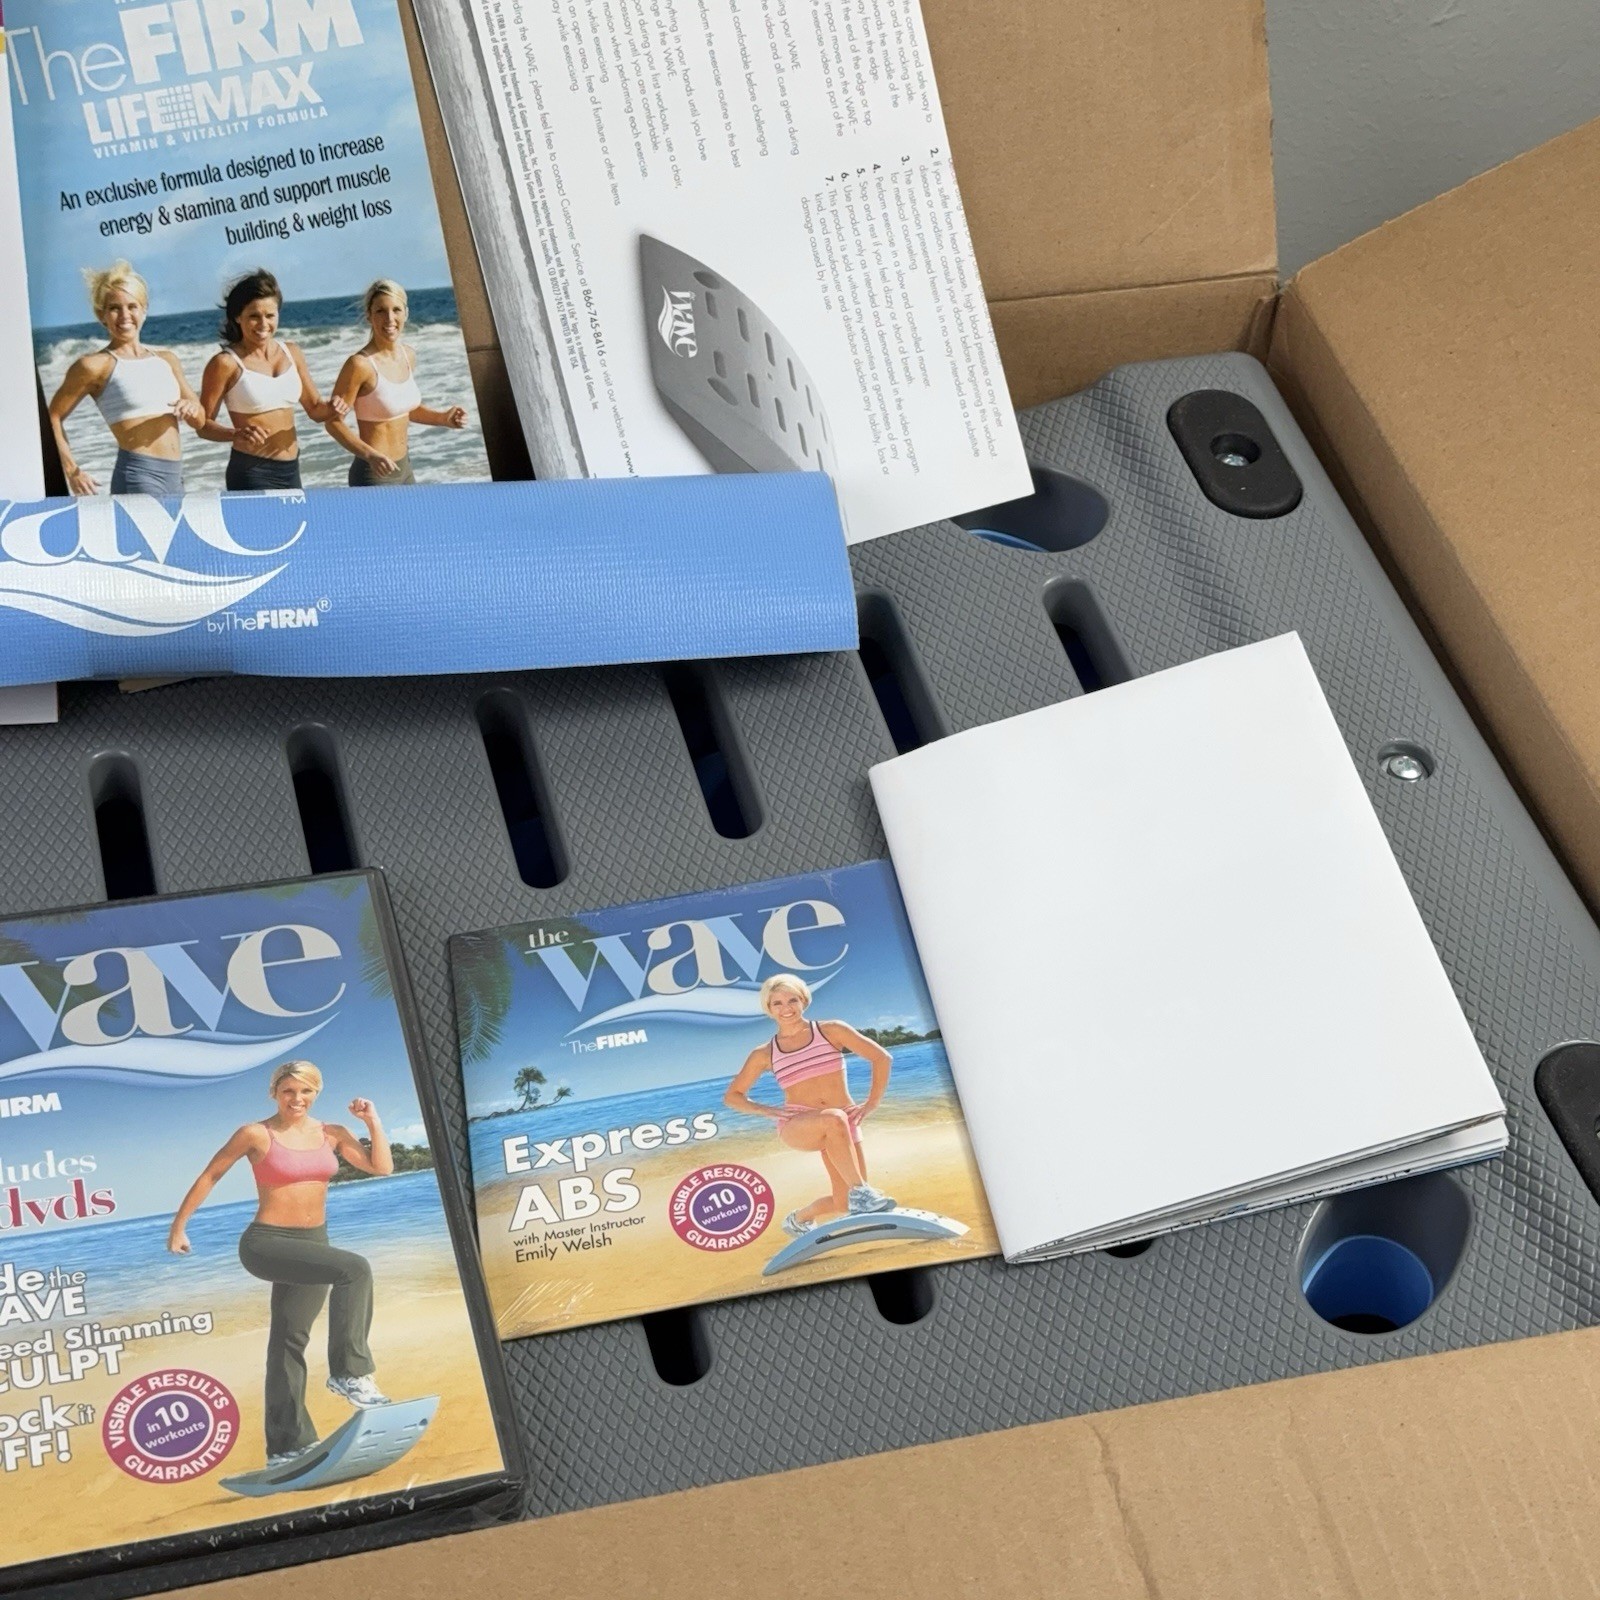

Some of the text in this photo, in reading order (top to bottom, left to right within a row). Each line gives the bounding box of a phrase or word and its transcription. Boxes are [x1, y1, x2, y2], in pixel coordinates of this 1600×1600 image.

[602, 1, 616, 34] motion
[518, 26, 529, 42] the
[637, 18, 651, 50] during
[904, 16, 919, 48] correct
[523, 42, 539, 78] WAVE,
[610, 35, 622, 62] when
[642, 50, 657, 71] your
[911, 49, 925, 69] and
[650, 72, 662, 90] first
[811, 8, 845, 137] exercise video as part of the
[915, 70, 928, 90] safe
[528, 79, 545, 111] please
[613, 63, 634, 115] performing
[920, 91, 930, 112] way
[567, 5, 624, 207] an open area, free of furniture or other items
[654, 91, 670, 135] workouts,
[925, 113, 933, 124] to
[92, 106, 329, 159] VITAMIN & VITALITY FORMULA
[539, 111, 553, 130] feel
[628, 115, 642, 139] each
[544, 131, 554, 150] free
[664, 137, 675, 153] use
[548, 151, 557, 162] to
[668, 154, 677, 163] a
[872, 163, 882, 174] 4.
[60, 135, 385, 211] An exclusive formula designed to increase
[551, 163, 567, 197] contact
[670, 163, 684, 189] chair,
[840, 171, 850, 183] 6.
[856, 167, 866, 178] 5.
[99, 164, 391, 237] energy & stamina and support muscle
[842, 184, 853, 203] Use
[858, 180, 869, 202] Stop
[874, 175, 888, 211] Perform
[225, 199, 393, 246] building & weight loss
[560, 198, 577, 241] Customer
[800, 196, 815, 235] damage
[844, 204, 862, 238] product
[863, 203, 877, 222] and
[867, 223, 879, 240] rest
[881, 211, 896, 248] exercise
[570, 242, 585, 276] Service
[809, 236, 826, 269] caused
[854, 238, 867, 257] only
[871, 248, 884, 266] you
[890, 249, 899, 259] in
[815, 269, 827, 282] by
[859, 258, 868, 270] as
[878, 266, 892, 284] feel
[893, 260, 901, 268] a
[579, 277, 589, 288] at
[863, 271, 881, 309] intended
[895, 268, 907, 290] slow
[882, 285, 895, 310] dizzy
[900, 291, 915, 310] and
[582, 288, 607, 357] 866-745-8416
[872, 310, 886, 329] and
[889, 311, 898, 321] or
[891, 323, 905, 345] short
[905, 311, 926, 354] controlled
[877, 329, 901, 386] demonstrated
[897, 345, 909, 355] of
[599, 358, 608, 368] or
[602, 370, 614, 387] visit
[606, 388, 617, 403] our
[892, 387, 900, 396] in
[894, 397, 905, 411] the
[611, 404, 626, 439] website
[898, 412, 911, 437] video
[620, 439, 630, 450] at
[624, 450, 639, 479] www.
[0, 490, 307, 567] ave
[528, 928, 569, 949] the
[503, 1113, 718, 1173] Express
[508, 1167, 641, 1232] ABS
[673, 1167, 766, 1226] VISIBLE RESULTS
[702, 1188, 736, 1214] in 10
[686, 1203, 768, 1249] GUARANTEED
[701, 1204, 748, 1226] workouts
[513, 1216, 646, 1247] with Master Instructor
[515, 1232, 612, 1263] Emily Welsh
[49, 1266, 87, 1288] the
[64, 1311, 213, 1350] Slimming
[78, 1403, 95, 1425] it
[108, 1373, 230, 1449] VISIBLE RESULTS
[146, 1401, 190, 1434] in 10
[145, 1421, 206, 1449] workouts
[0, 1427, 72, 1472] FF!
[124, 1420, 232, 1480] GUARANTEED
